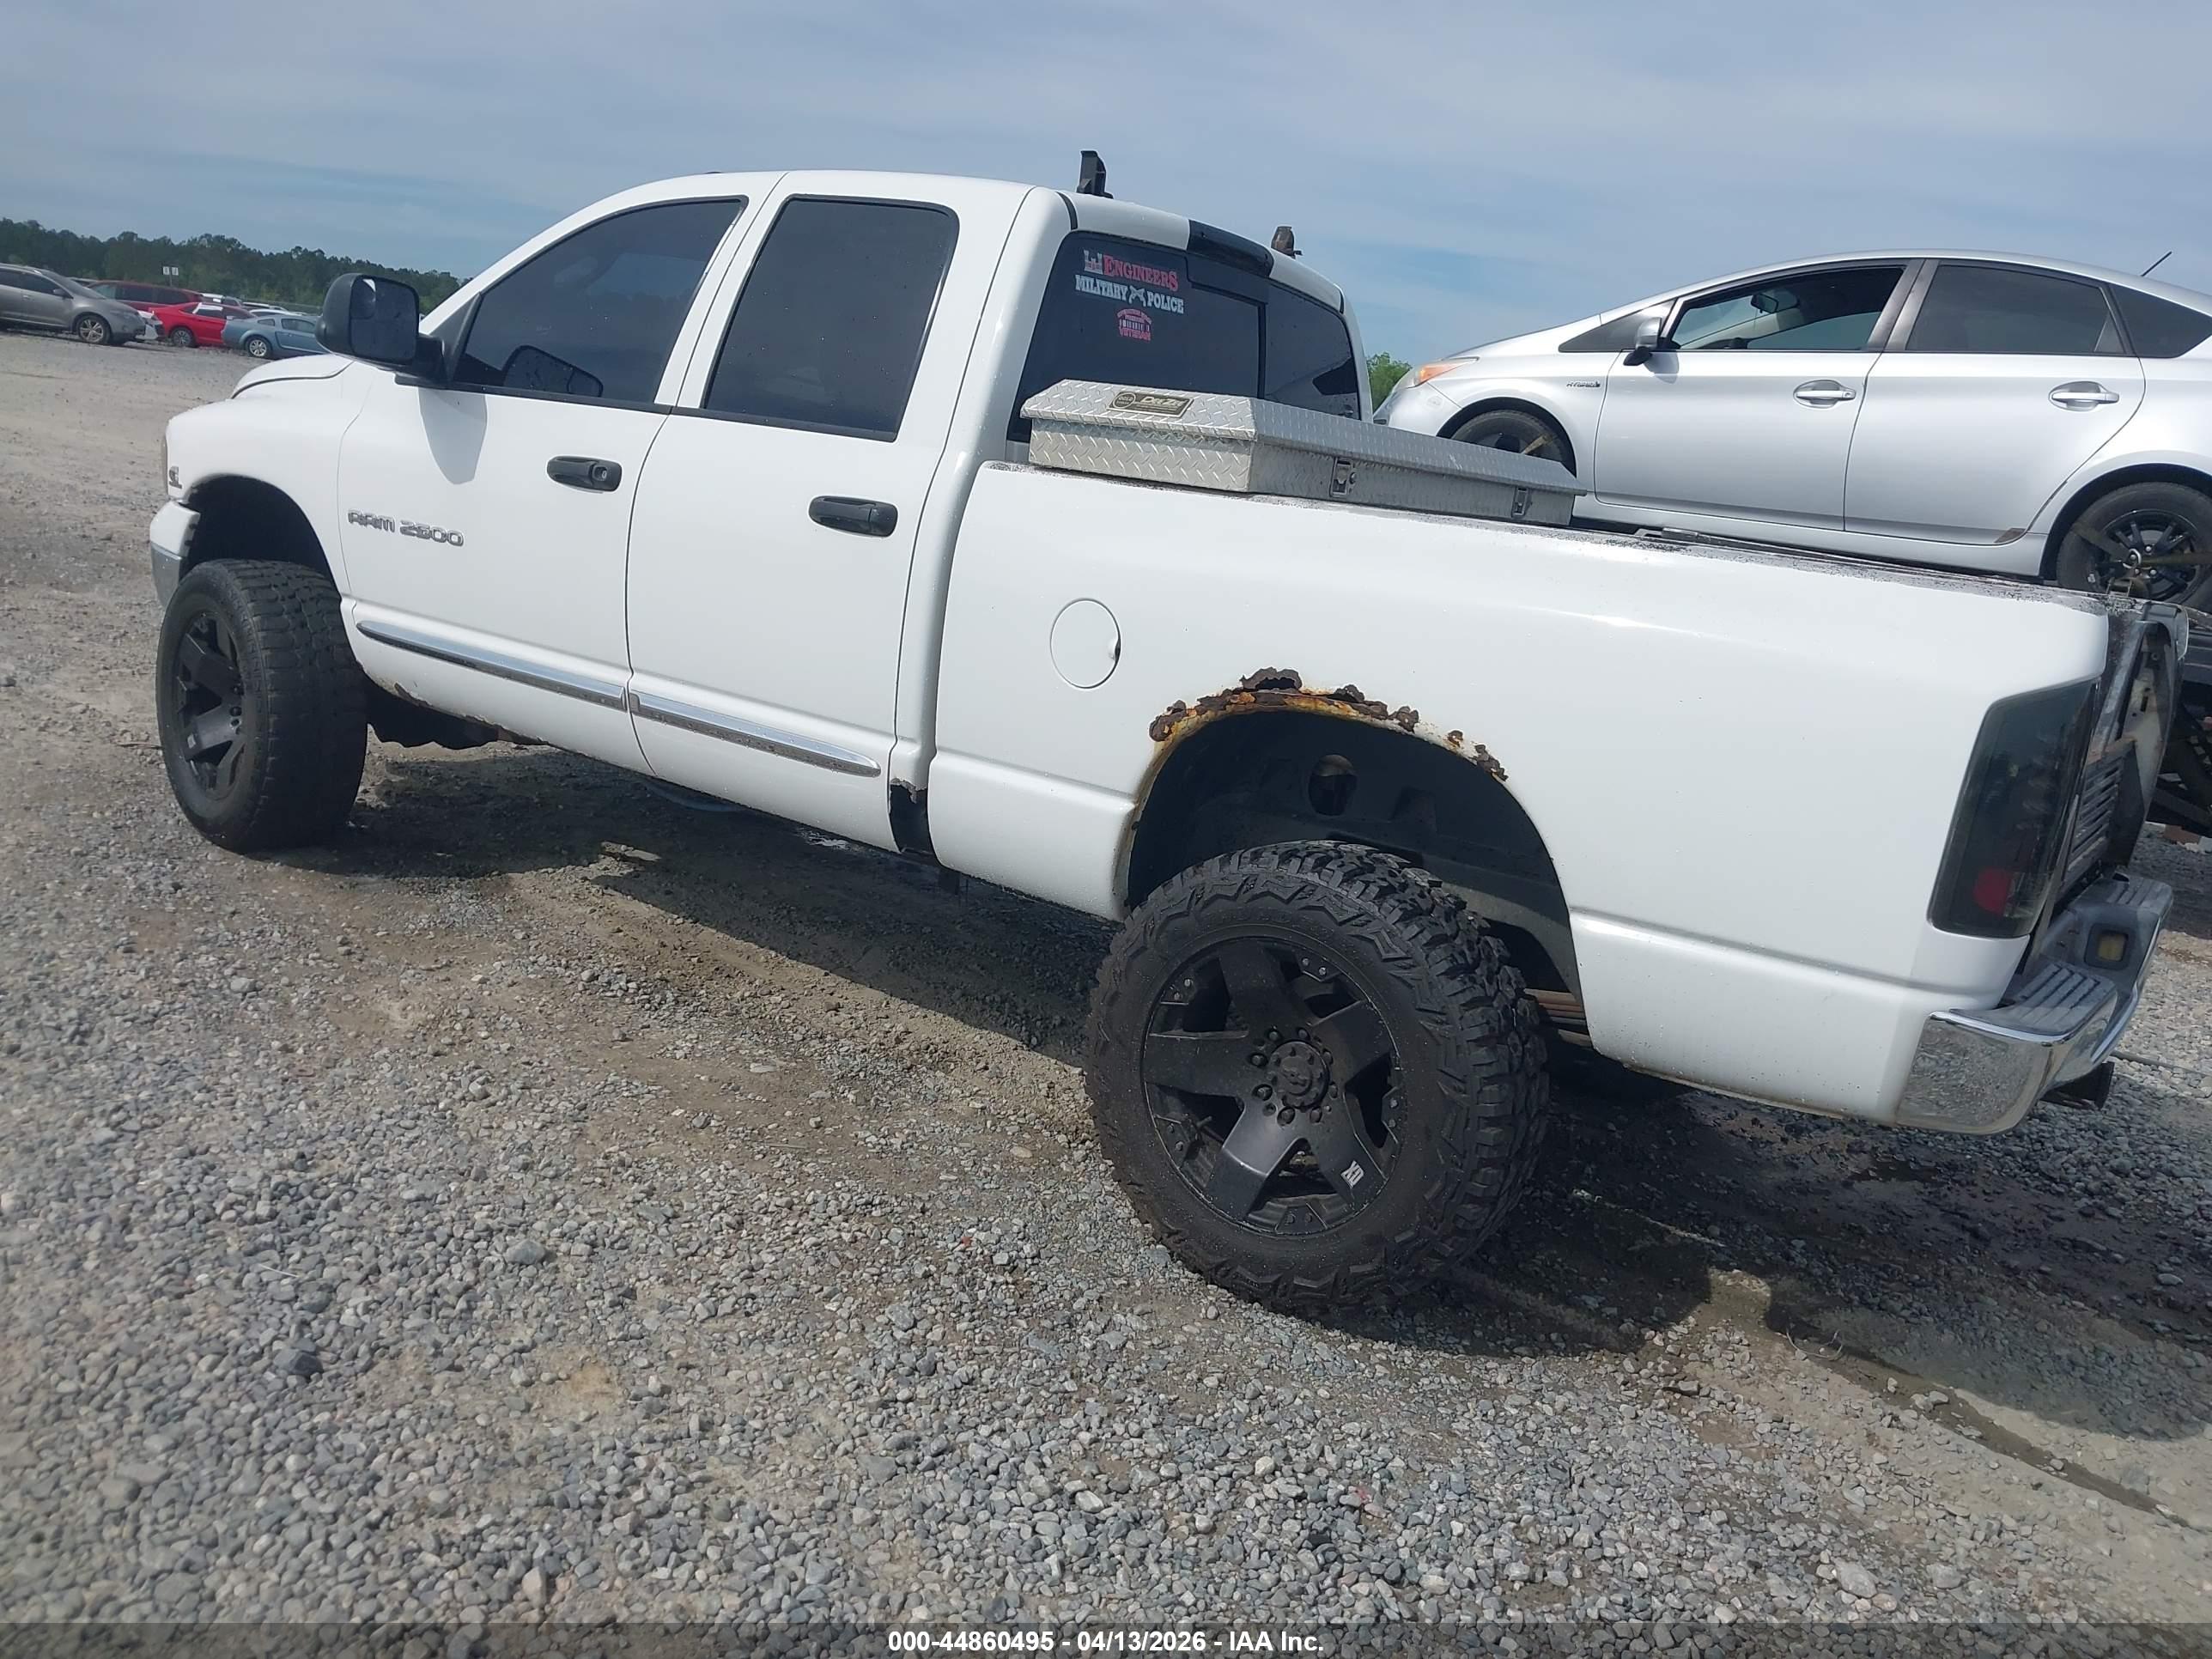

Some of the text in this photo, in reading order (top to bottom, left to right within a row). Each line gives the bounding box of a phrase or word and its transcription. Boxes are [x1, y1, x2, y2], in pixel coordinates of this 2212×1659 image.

[1075, 274, 1185, 314] MILITARY POLICE
[348, 510, 464, 546] RAM 2500
